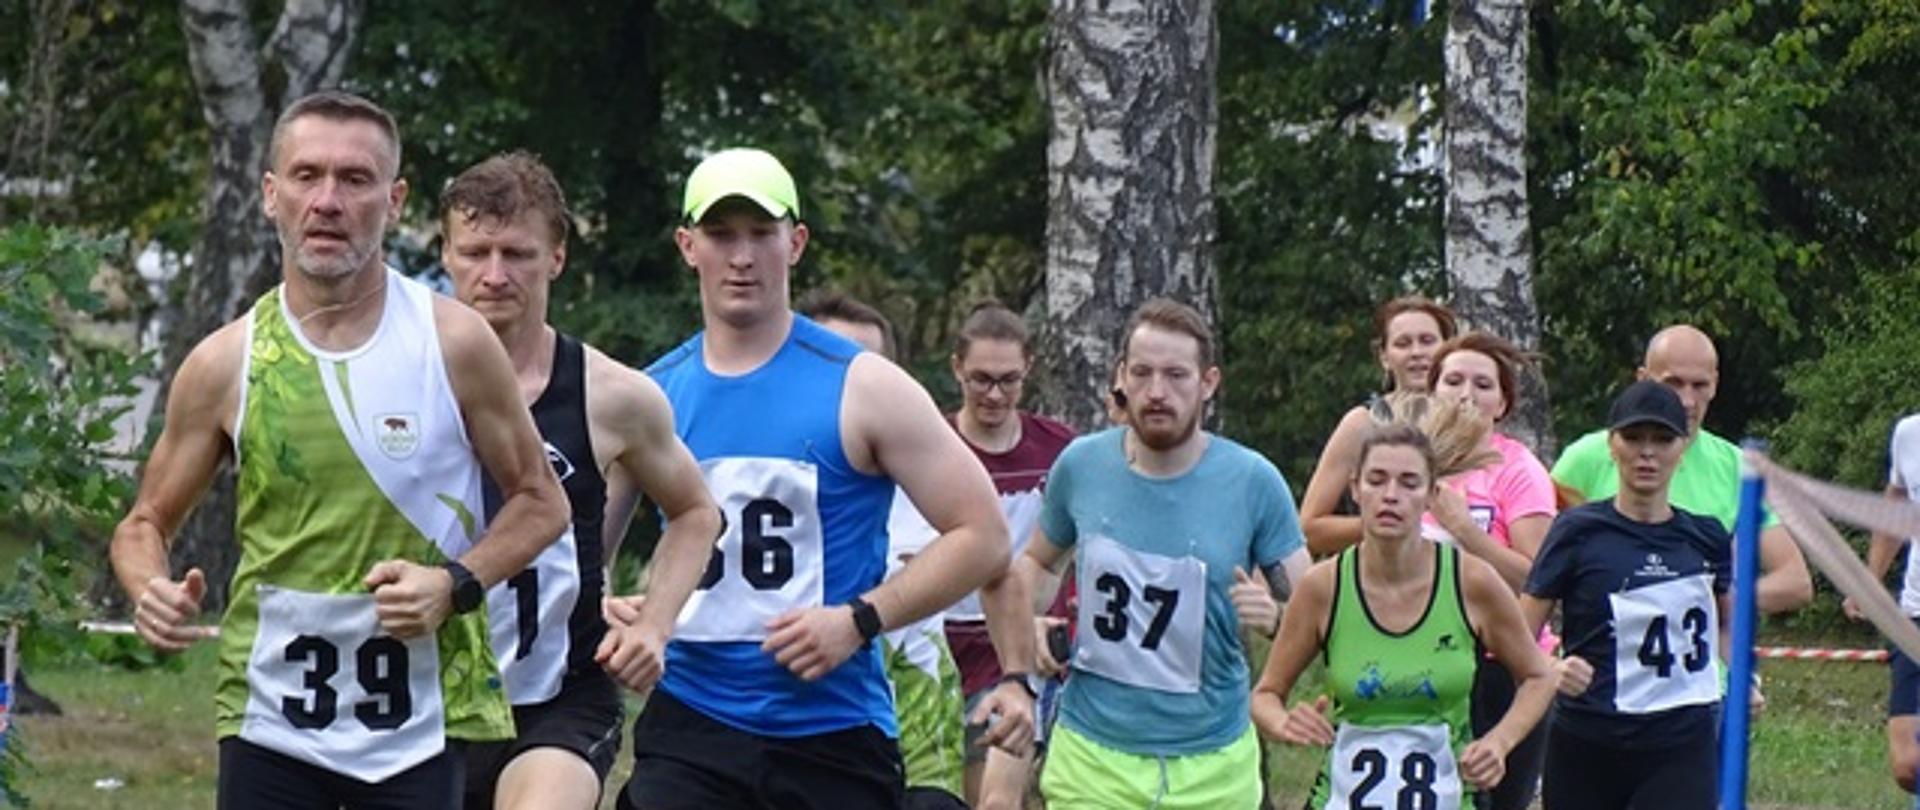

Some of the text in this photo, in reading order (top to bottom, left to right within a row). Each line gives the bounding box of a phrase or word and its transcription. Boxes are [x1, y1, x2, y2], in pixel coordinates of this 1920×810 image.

[1093, 571, 1180, 652] 37
[1636, 607, 1710, 678] 43
[282, 635, 411, 730] 39
[1348, 749, 1438, 810] 28
